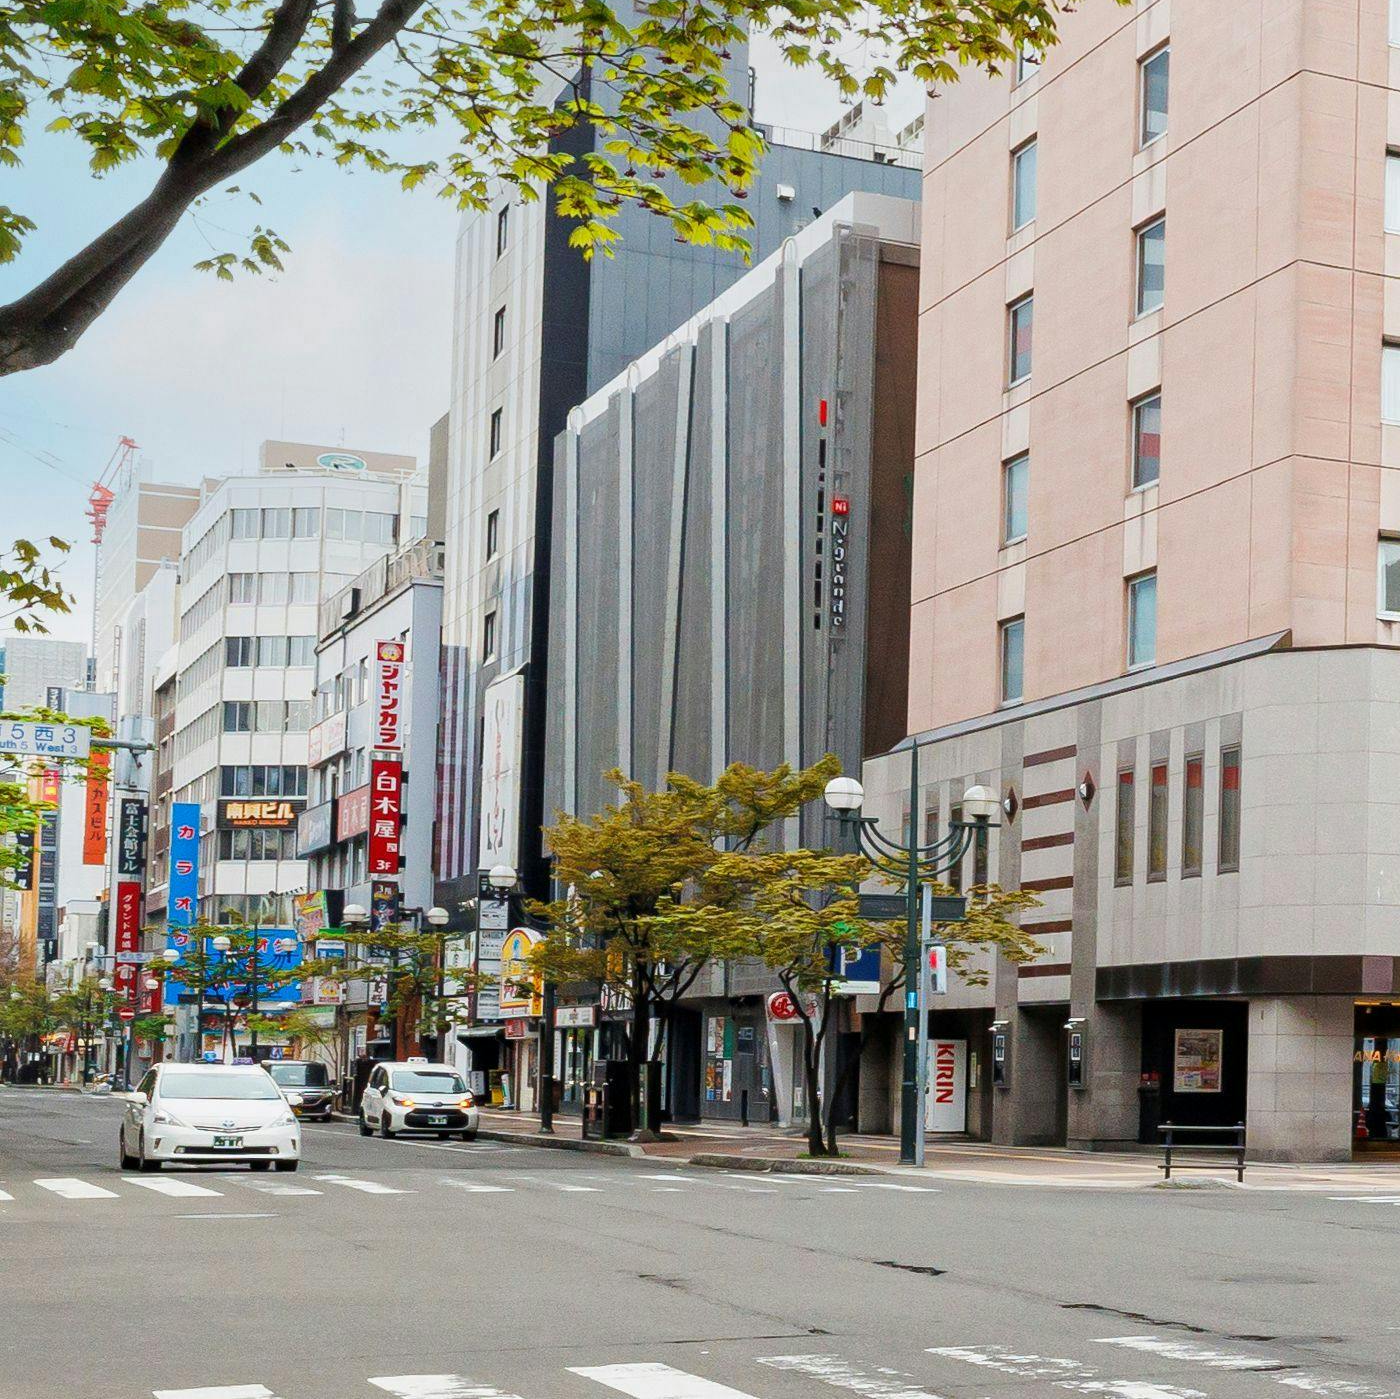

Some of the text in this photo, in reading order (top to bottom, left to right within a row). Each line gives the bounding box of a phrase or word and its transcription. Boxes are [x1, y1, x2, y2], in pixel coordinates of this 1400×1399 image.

[379, 664, 399, 743] ジャンカラ
[35, 742, 64, 753] West
[373, 771, 398, 838] 白木屋
[123, 803, 141, 871] 富士会館ビル
[376, 860, 391, 871] 3F
[936, 1043, 955, 1103] KIRIN
[1353, 1050, 1381, 1063] ANA
